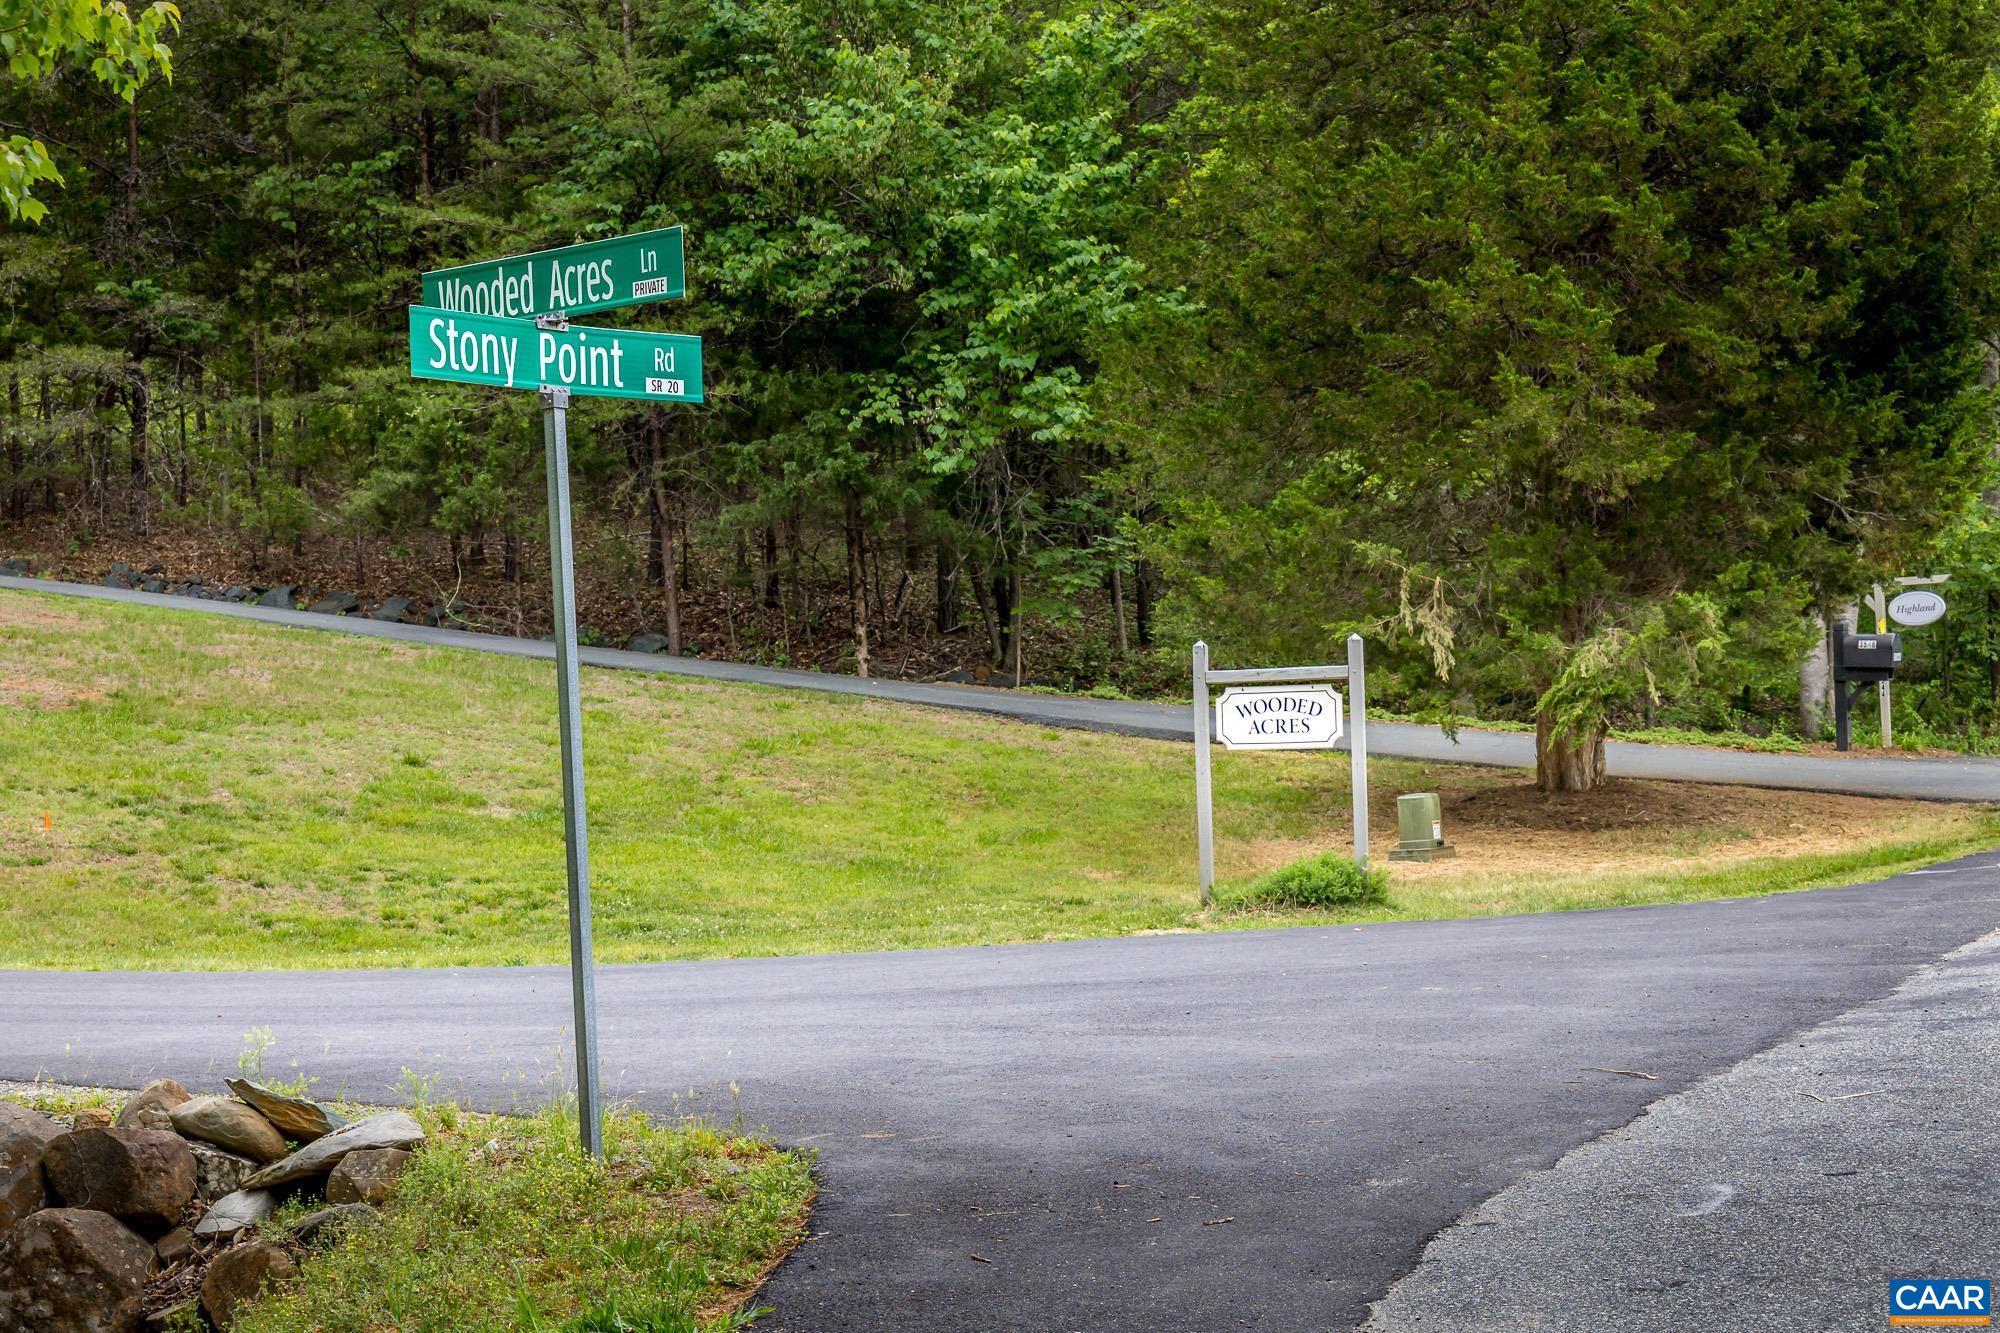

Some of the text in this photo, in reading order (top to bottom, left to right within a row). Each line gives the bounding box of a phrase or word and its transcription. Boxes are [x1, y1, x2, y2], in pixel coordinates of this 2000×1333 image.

[438, 248, 657, 317] Wooded Acres Ln
[634, 279, 665, 296] PRIVATE
[429, 318, 675, 387] Stony Point Rd
[651, 379, 679, 393] SR 20
[1896, 603, 1936, 615] Highland
[1235, 697, 1323, 719] WOODED
[1249, 718, 1311, 735] ACRES
